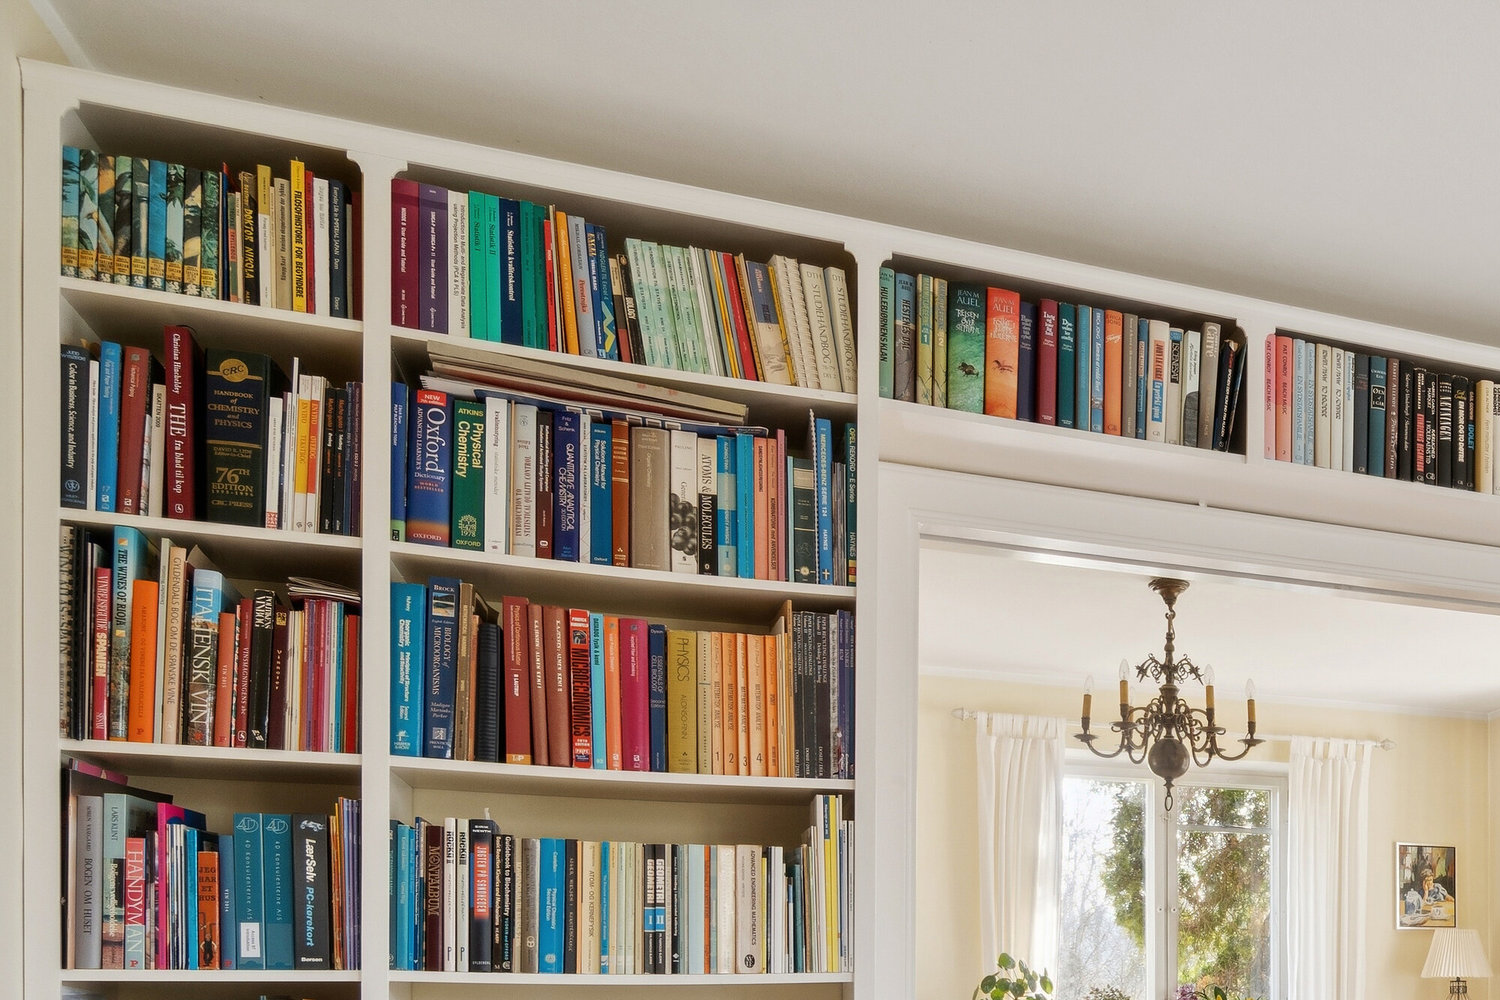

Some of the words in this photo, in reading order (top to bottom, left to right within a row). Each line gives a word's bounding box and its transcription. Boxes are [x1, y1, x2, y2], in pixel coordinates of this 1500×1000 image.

[244, 209, 254, 242] DOKTOR
[294, 191, 302, 244] FILOSOFIHISTORIE
[588, 233, 596, 257] EXCEL
[245, 247, 254, 278] NIKOLA
[626, 297, 636, 319] BIOLOGY
[880, 286, 888, 342] HULEBJØRNENS
[957, 297, 980, 307] AUEL
[993, 303, 1014, 314] AUEL
[902, 299, 911, 335] HESTENES
[902, 337, 911, 351] DAL
[923, 334, 928, 343] 1
[939, 338, 944, 347] 2
[1205, 325, 1218, 358] Carré
[222, 364, 244, 376] CRC
[1171, 342, 1179, 381] ISCENESAT
[214, 390, 254, 399] HANDBOOK
[169, 403, 186, 436] THE
[208, 403, 260, 415] CHEMISTRY
[458, 407, 484, 418] ATKINS
[214, 419, 252, 429] PHYSICS
[425, 407, 446, 473] Oxford
[456, 421, 470, 477] Chemistry
[471, 423, 483, 468] Physical
[175, 452, 183, 468] blad
[566, 443, 575, 489] QUANTITATIVE
[702, 454, 712, 484] ATOMS
[820, 434, 828, 486] MERCEDES-BENZ
[174, 480, 183, 493] kop
[215, 466, 250, 484] 76TH
[414, 471, 445, 482] Dictionary
[559, 467, 567, 507] CHEMISTRY
[212, 483, 253, 492] EDITION
[566, 491, 575, 531] ANALYTICAL
[701, 495, 712, 550] MOLECULES
[413, 531, 442, 542] OXFORD
[118, 549, 128, 564] THE
[117, 566, 127, 590] WINES
[172, 557, 182, 605] GYLDENDALS
[117, 591, 127, 602] OF
[116, 604, 126, 626] RIOJA
[170, 607, 179, 625] BOG
[254, 596, 265, 628] VINBOG
[170, 626, 178, 640] OM
[443, 627, 452, 661] BIOLOGY
[96, 632, 107, 677] SPANIEN
[170, 642, 178, 652] DE
[168, 654, 177, 686] SPANSKE
[432, 627, 441, 695] MICROORGANISMS
[676, 637, 689, 682] PHYSICS
[167, 688, 176, 705] VINE
[571, 648, 590, 736] MICROECONOMICS
[190, 685, 208, 724] VIN
[715, 751, 720, 762] 1
[728, 753, 735, 764] 2
[742, 756, 748, 766] 3
[755, 752, 763, 764] 4
[84, 858, 92, 886] BOGEN
[646, 859, 655, 904] GEOMETRI
[656, 859, 665, 904] GEOMETRI
[83, 890, 92, 905] OM
[127, 850, 143, 953] HANDYMAN
[83, 909, 92, 934] HUSET
